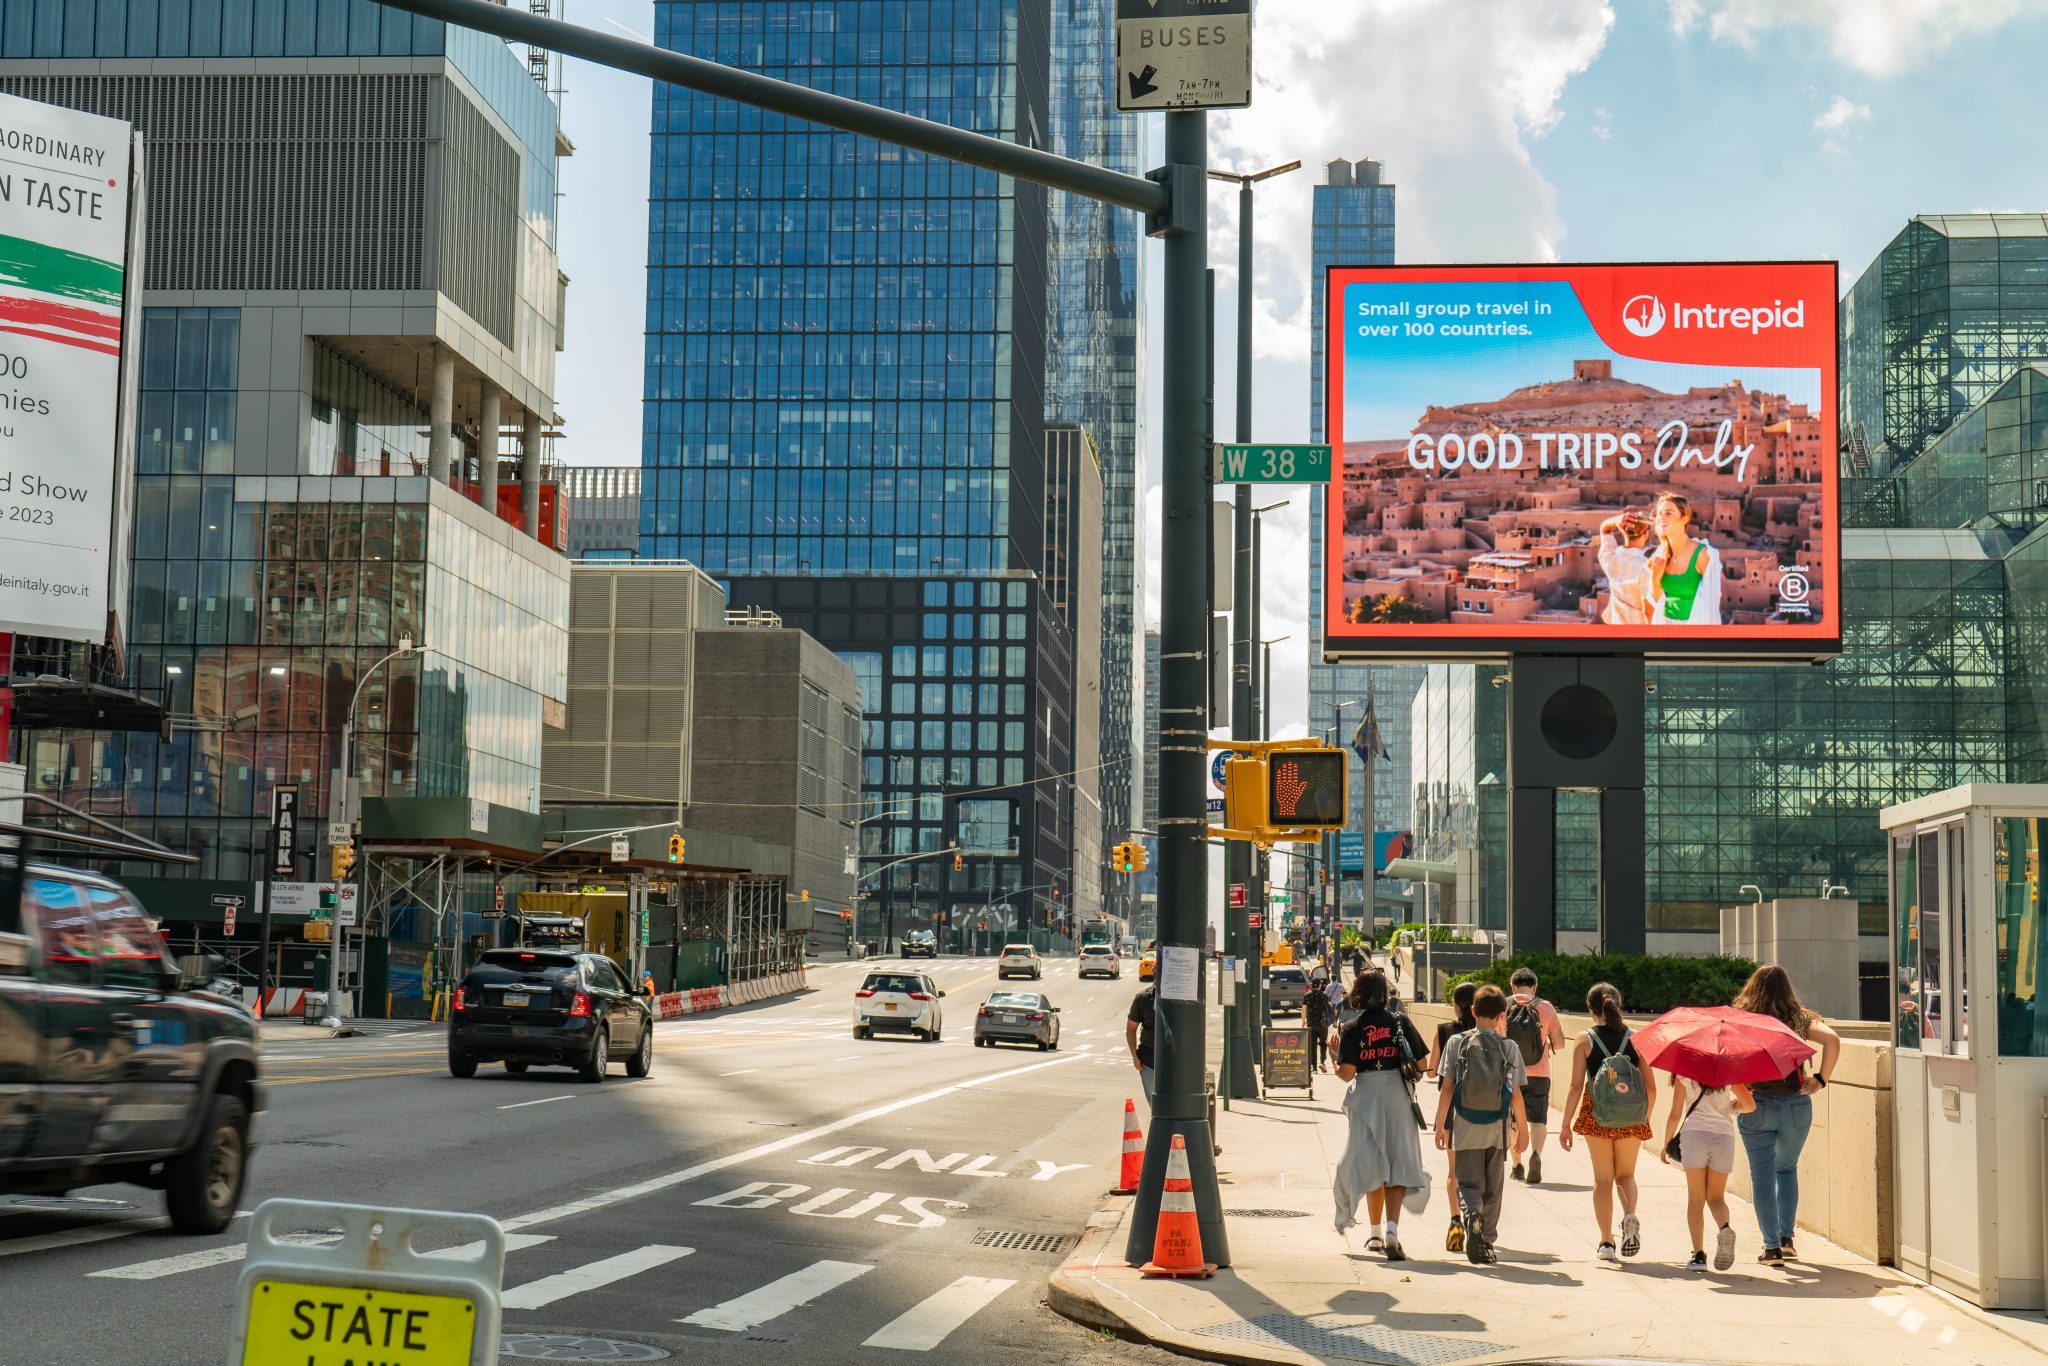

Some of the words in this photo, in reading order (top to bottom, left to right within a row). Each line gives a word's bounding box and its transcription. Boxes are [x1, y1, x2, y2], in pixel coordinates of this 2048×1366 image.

[1140, 25, 1226, 48] BUSES
[23, 178, 103, 221] TASTE
[1358, 301, 1410, 316] Small
[1415, 302, 1471, 318] group
[1476, 300, 1529, 315] travel
[1534, 299, 1552, 314] in
[1673, 299, 1805, 335] Intrepid
[1358, 324, 1399, 337] over
[1404, 322, 1435, 336] 100
[1440, 321, 1533, 336] countries.
[1226, 449, 1248, 478] W
[1260, 448, 1295, 479] 38
[1308, 450, 1325, 465] ST
[1407, 432, 1523, 470] GOOD
[1531, 432, 1643, 470] TRIPS
[1653, 418, 1755, 483] Only
[21, 474, 88, 503] Show
[9, 506, 54, 526] 2023
[277, 793, 293, 866] PARK
[1363, 1025, 1391, 1046] Patta
[1360, 1046, 1398, 1060] ORDER
[796, 1146, 1094, 1181] ONLY
[690, 1181, 970, 1228] BUS
[1170, 1230, 1182, 1238] PA
[289, 1300, 430, 1351] STATE
